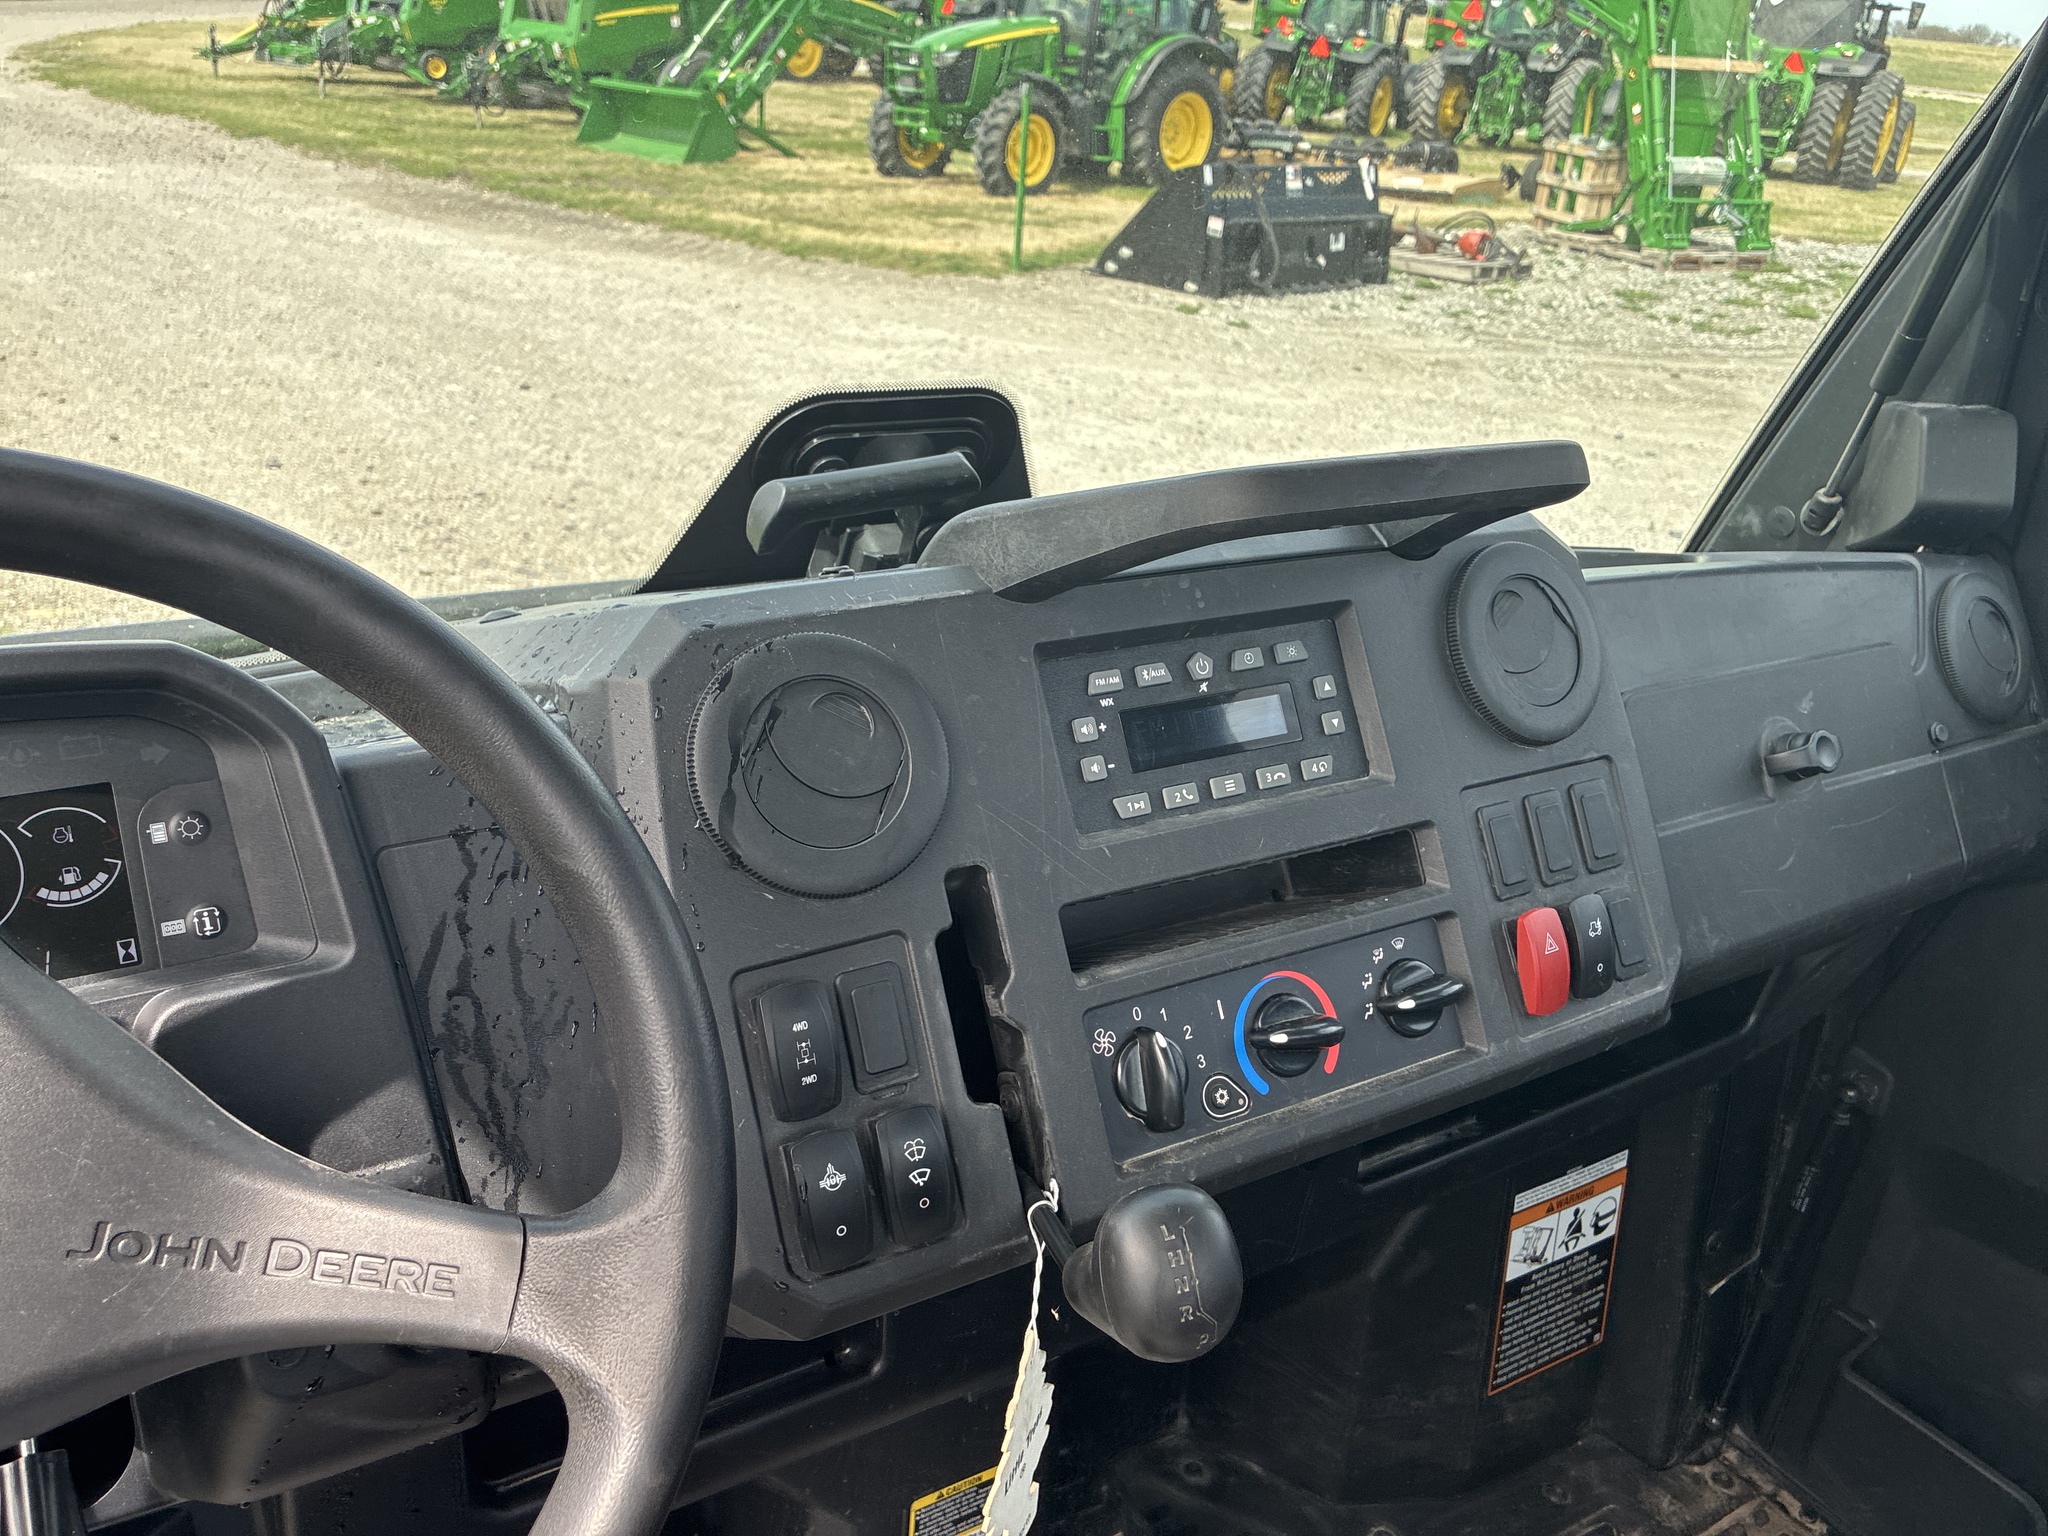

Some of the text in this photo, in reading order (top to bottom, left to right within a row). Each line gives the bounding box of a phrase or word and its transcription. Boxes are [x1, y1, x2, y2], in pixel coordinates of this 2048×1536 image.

[1099, 697, 1115, 707] WX
[1311, 763, 1318, 773] 4
[1265, 773, 1272, 783] 3
[1174, 792, 1182, 803] 2
[1126, 801, 1133, 812] 1
[1132, 1006, 1142, 1021] 0
[1160, 1007, 1167, 1021] 1
[792, 1021, 808, 1032] 4WD
[1183, 1025, 1193, 1040] 2
[1196, 1054, 1206, 1068] 3
[802, 1074, 817, 1085] 2WD
[1556, 1185, 1595, 1209] WARNING
[1160, 1224, 1176, 1241] L
[65, 1220, 461, 1299] JOHN DEERE
[1167, 1249, 1185, 1268] H
[1174, 1275, 1190, 1295] N
[1179, 1305, 1194, 1323] R
[945, 1474, 984, 1496] CAUTION
